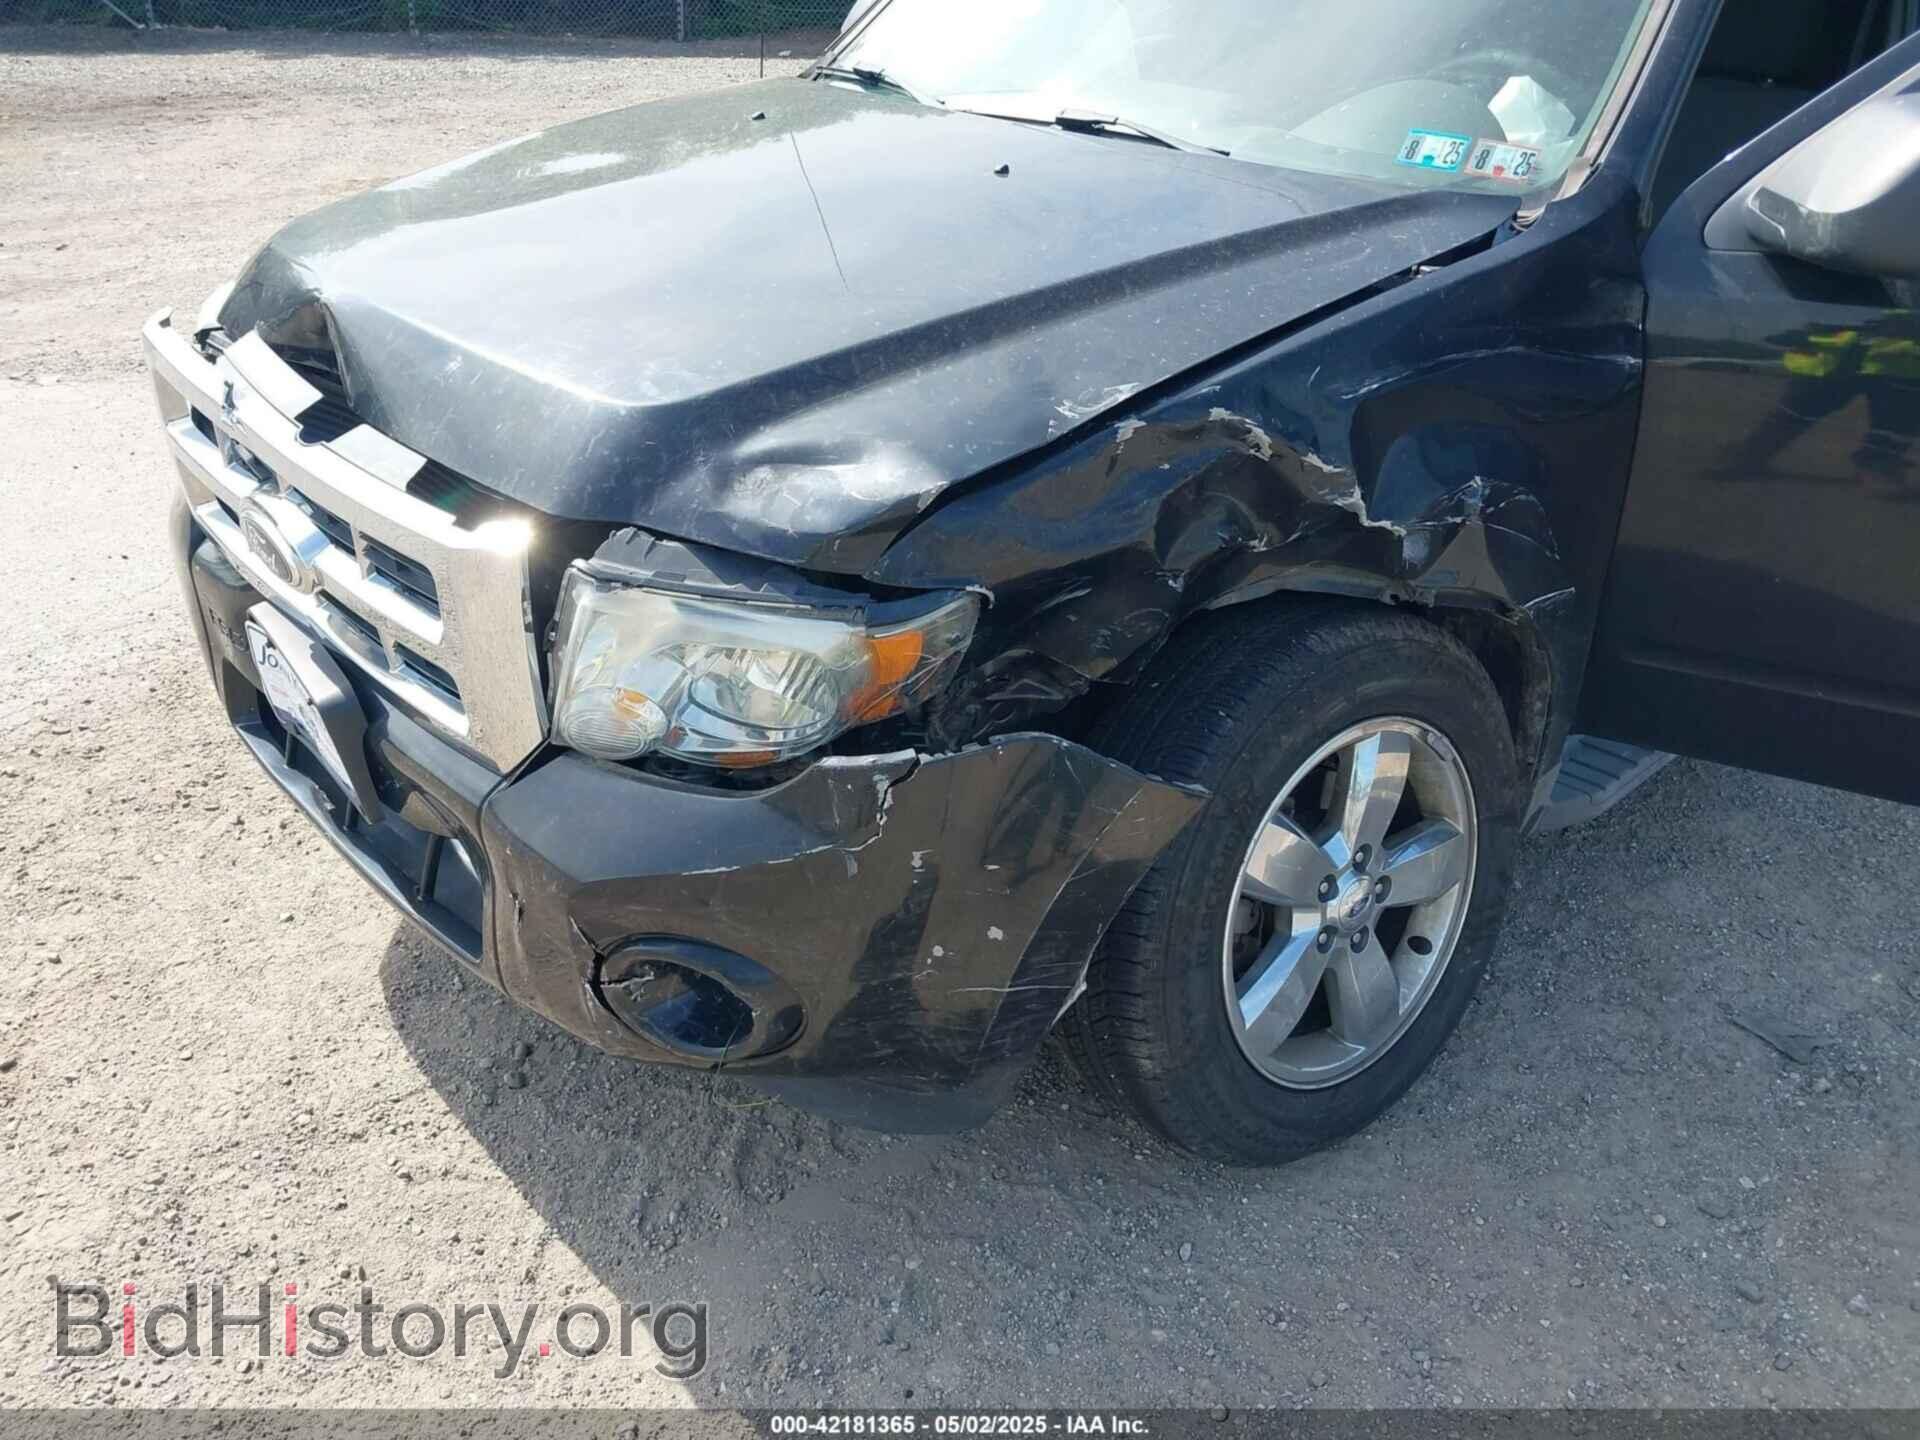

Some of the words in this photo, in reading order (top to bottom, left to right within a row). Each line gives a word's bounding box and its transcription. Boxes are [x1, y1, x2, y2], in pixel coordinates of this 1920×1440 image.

[1405, 140, 1420, 160] 8
[1442, 141, 1465, 165] 25
[1475, 149, 1490, 170] 8
[1513, 152, 1536, 176] 25
